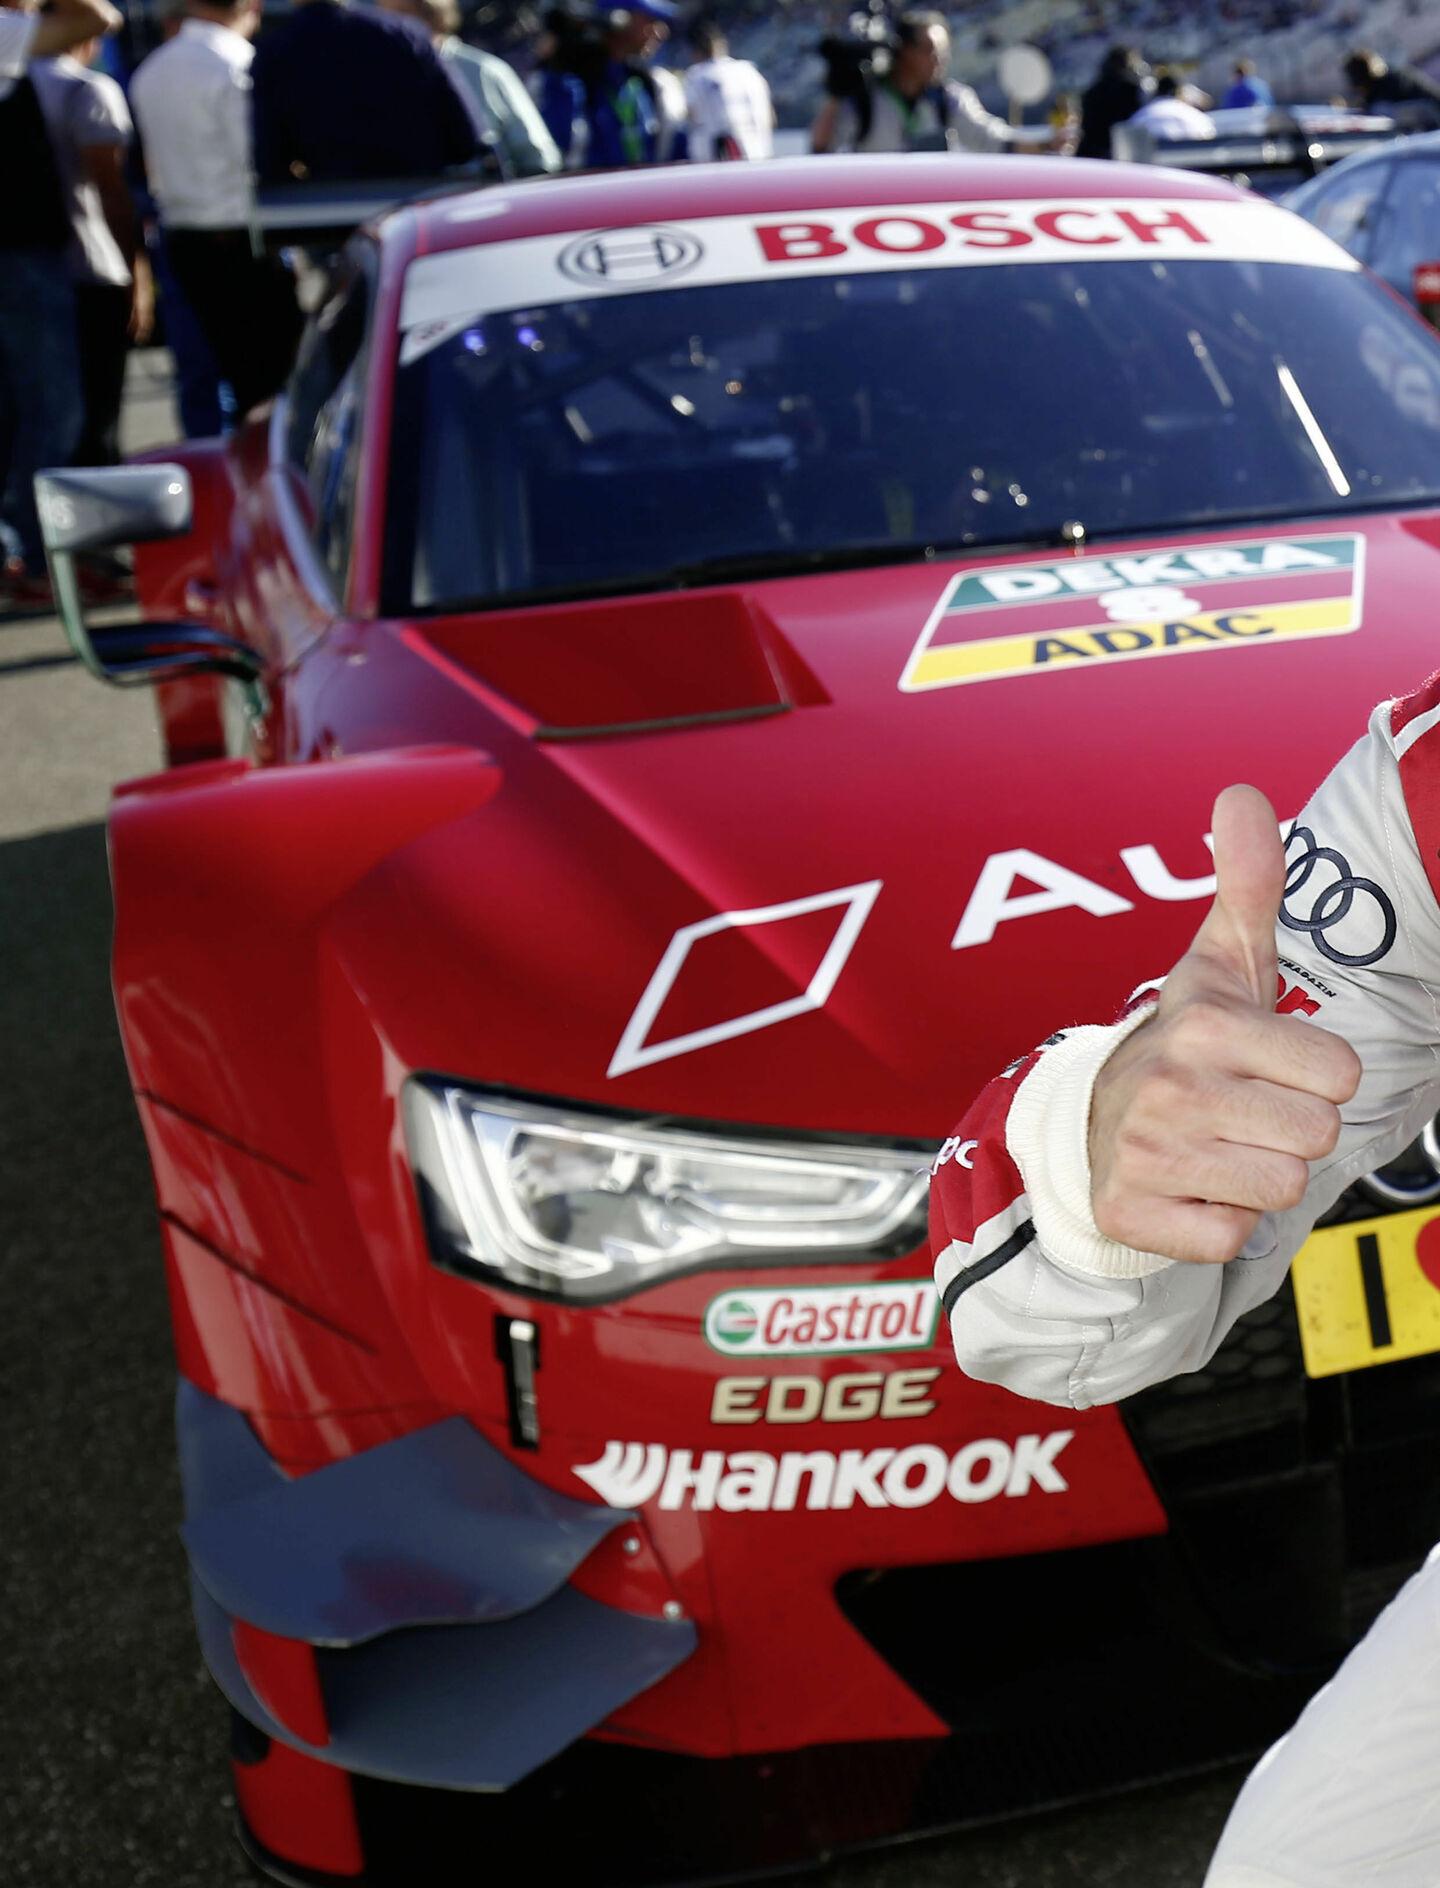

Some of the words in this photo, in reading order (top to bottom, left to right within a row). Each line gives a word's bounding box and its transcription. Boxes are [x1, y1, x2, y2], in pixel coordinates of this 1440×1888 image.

[753, 209, 1212, 263] BOSCH
[979, 542, 1340, 602] DEKRA
[1032, 614, 1276, 665] ADAC
[763, 1290, 926, 1345] Castrol
[1356, 1232, 1393, 1350] I
[709, 1367, 943, 1424] EDGE
